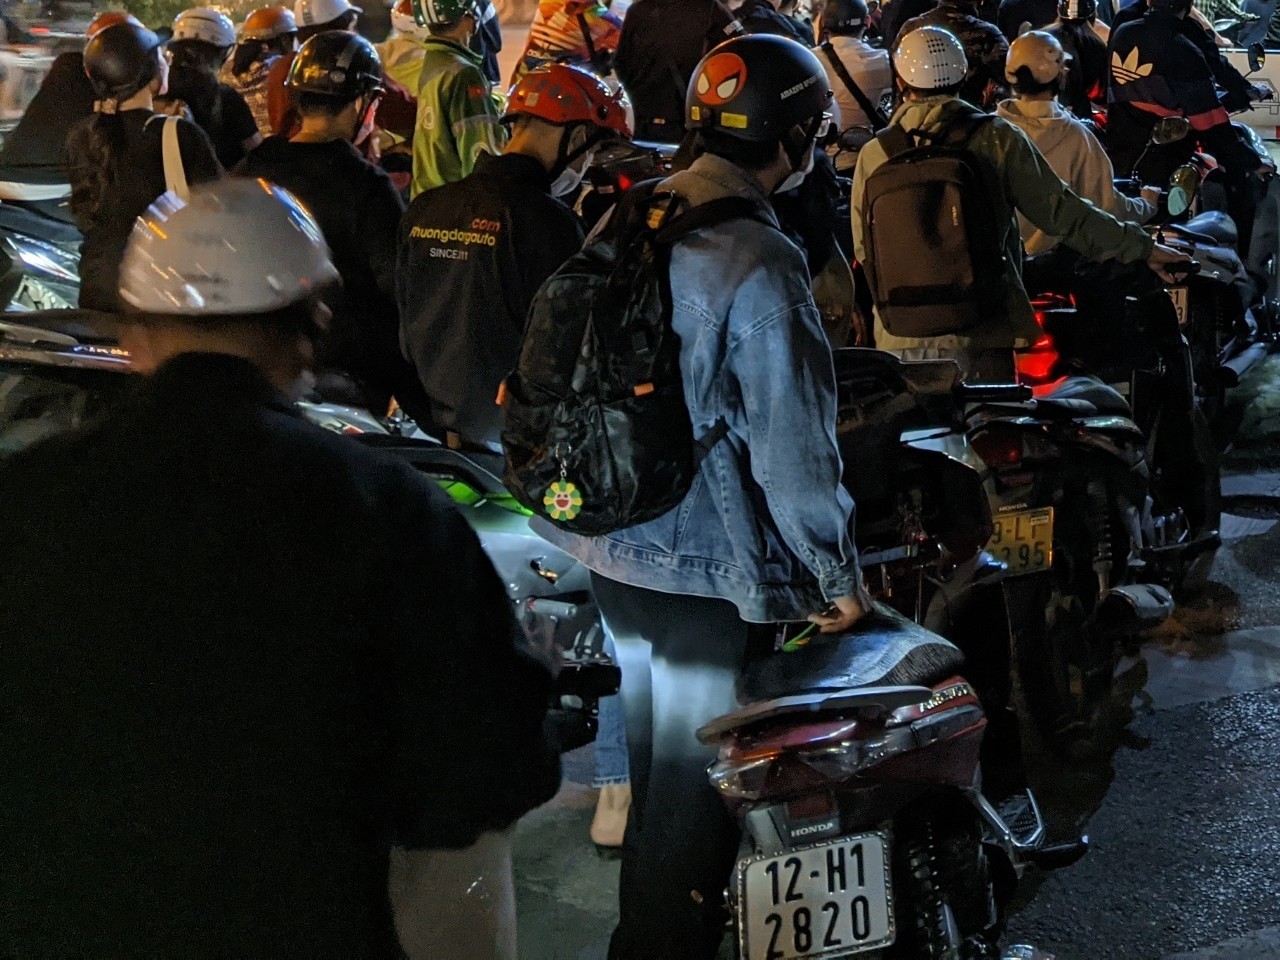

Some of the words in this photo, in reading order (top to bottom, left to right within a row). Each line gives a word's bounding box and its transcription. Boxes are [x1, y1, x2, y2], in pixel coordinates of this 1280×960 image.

[791, 822, 833, 838] HONDA
[764, 842, 865, 907] 12-H1
[764, 894, 871, 960] 2820
